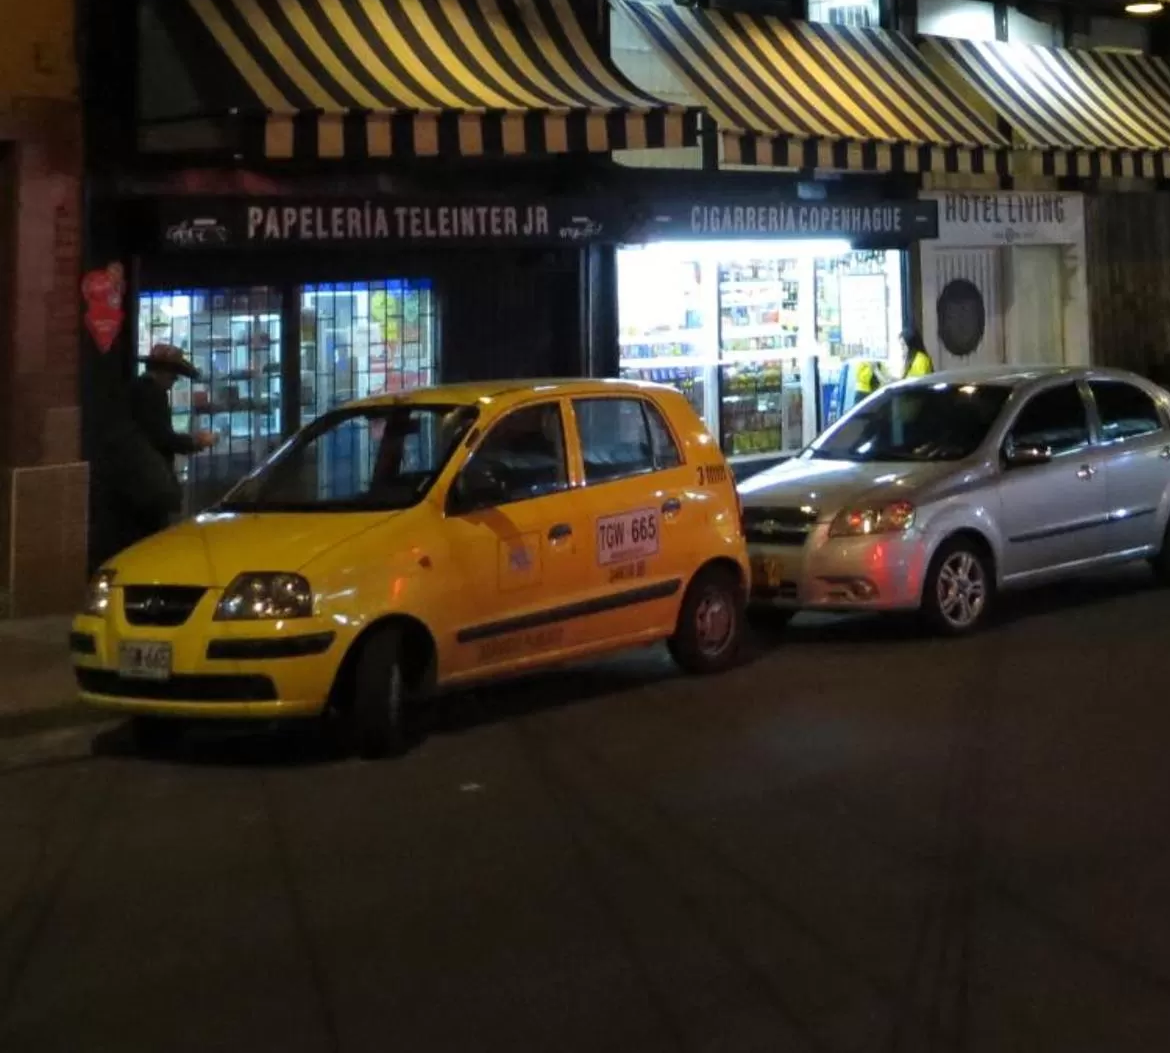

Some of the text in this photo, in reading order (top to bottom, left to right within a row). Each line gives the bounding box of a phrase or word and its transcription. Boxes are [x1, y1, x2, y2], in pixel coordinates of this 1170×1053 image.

[247, 200, 550, 239] PAPELERÍA TELEINTER JR
[690, 201, 902, 233] CIGARRERÍA COPENHAGUE
[945, 193, 1065, 225] HOTEL LIVING
[600, 513, 657, 551] TGW 665
